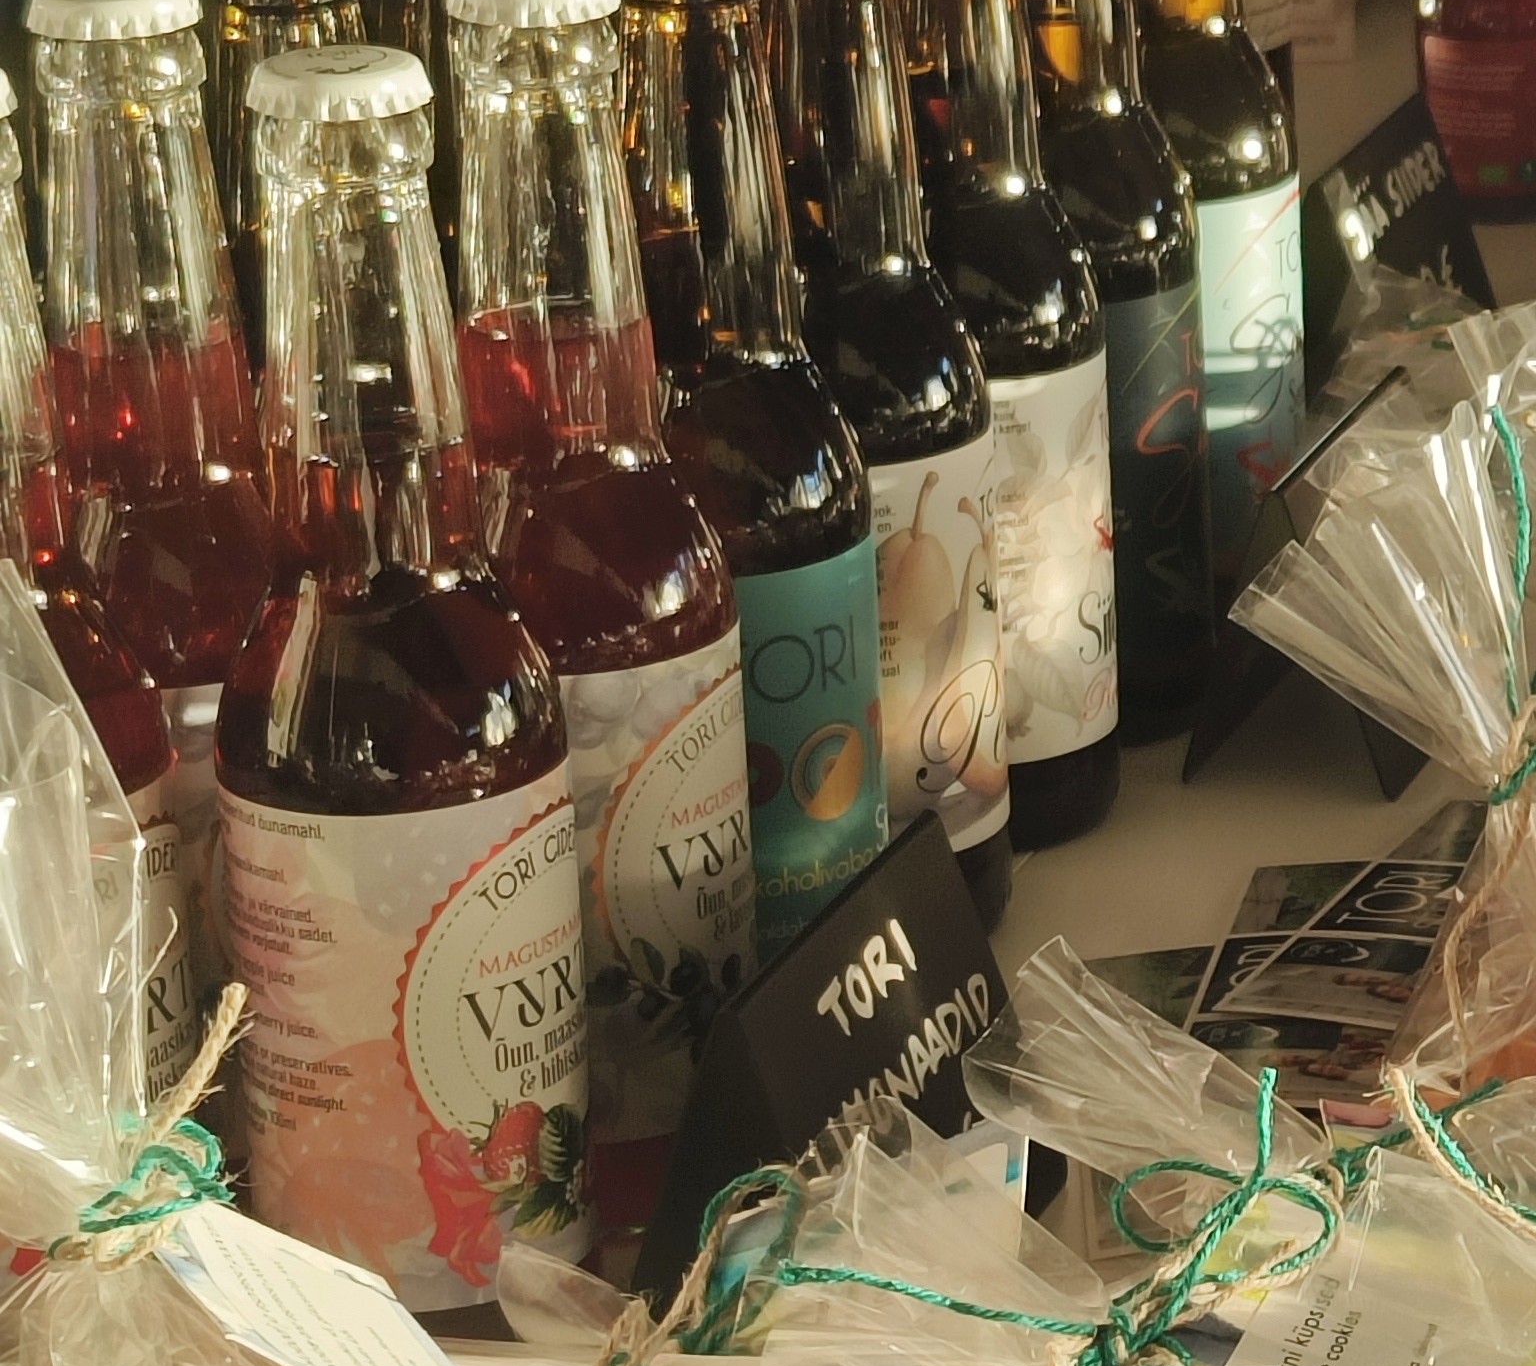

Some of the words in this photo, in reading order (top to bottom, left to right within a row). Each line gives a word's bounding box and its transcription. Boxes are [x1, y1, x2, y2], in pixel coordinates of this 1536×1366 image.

[748, 614, 857, 704] ORI
[666, 714, 716, 775] TORI
[257, 813, 325, 842] õunamahl,
[479, 850, 536, 911] TORI
[543, 822, 576, 863] CIDE
[816, 918, 917, 1036] TORI
[271, 1050, 354, 1077] preservatives.
[1284, 1274, 1341, 1348] küpsised
[1327, 1309, 1363, 1362] cookies
